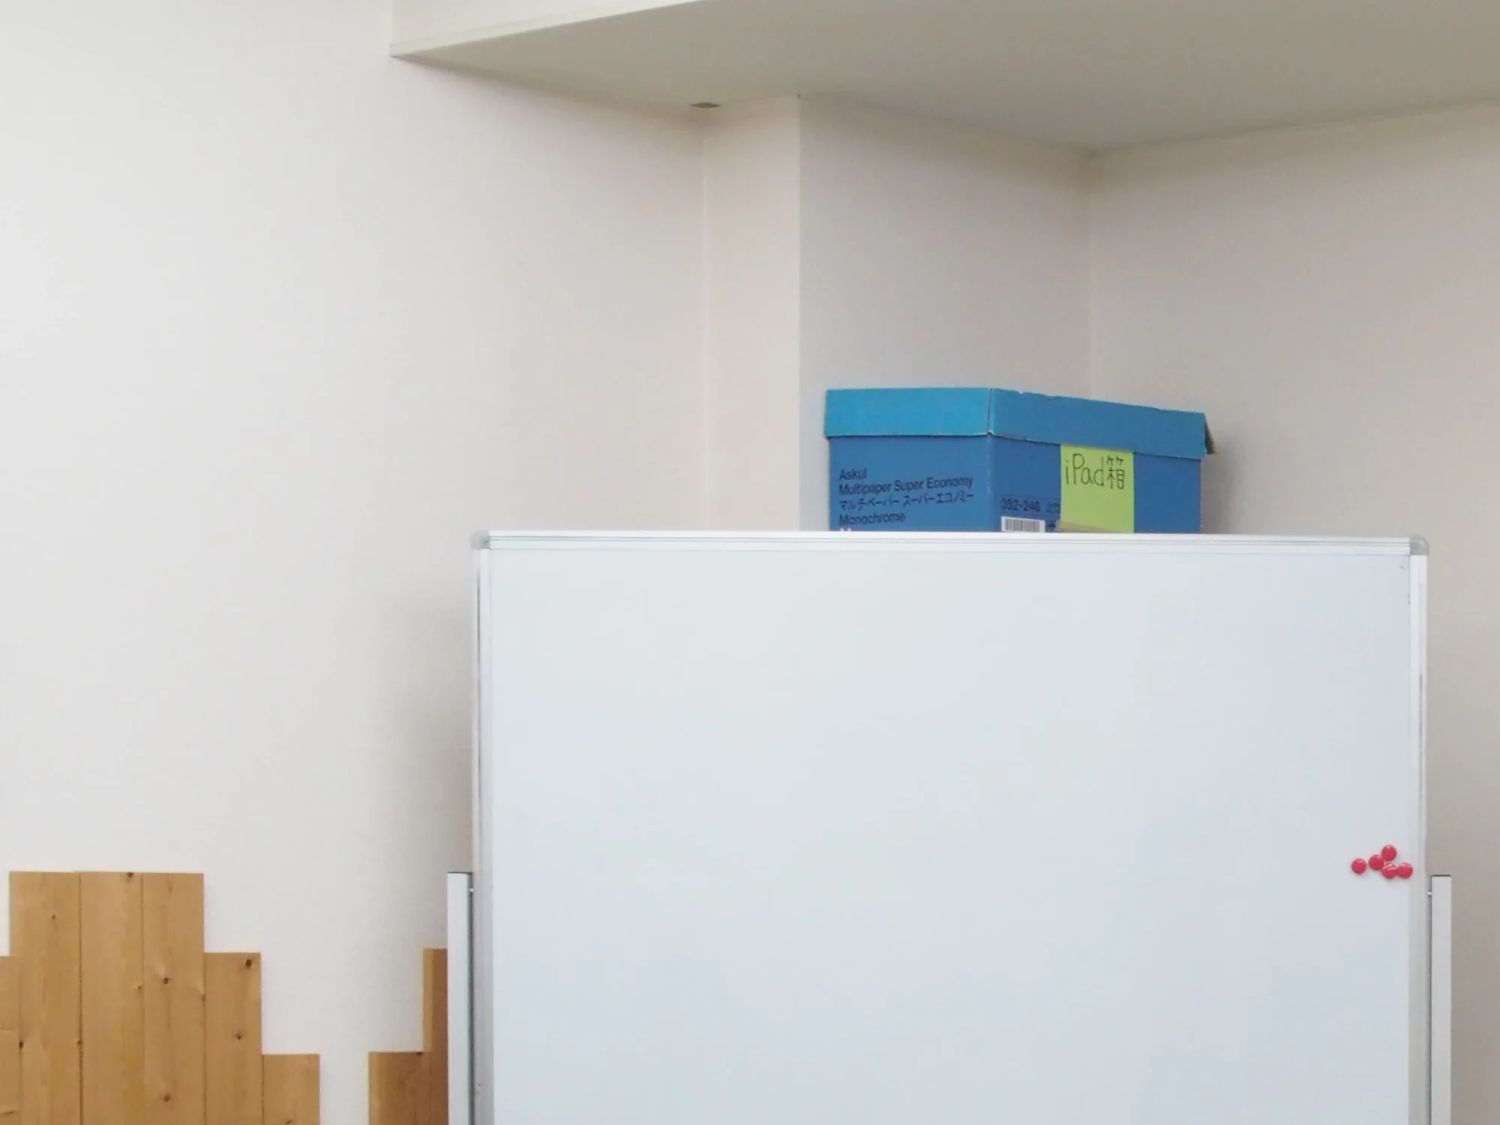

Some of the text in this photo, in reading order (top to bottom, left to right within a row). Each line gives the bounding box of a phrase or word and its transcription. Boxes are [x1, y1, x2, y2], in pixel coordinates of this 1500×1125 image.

[1064, 453, 1126, 490] iPad箱
[839, 476, 974, 496] Multipaper Super Economy
[839, 512, 906, 527] Monochrome
